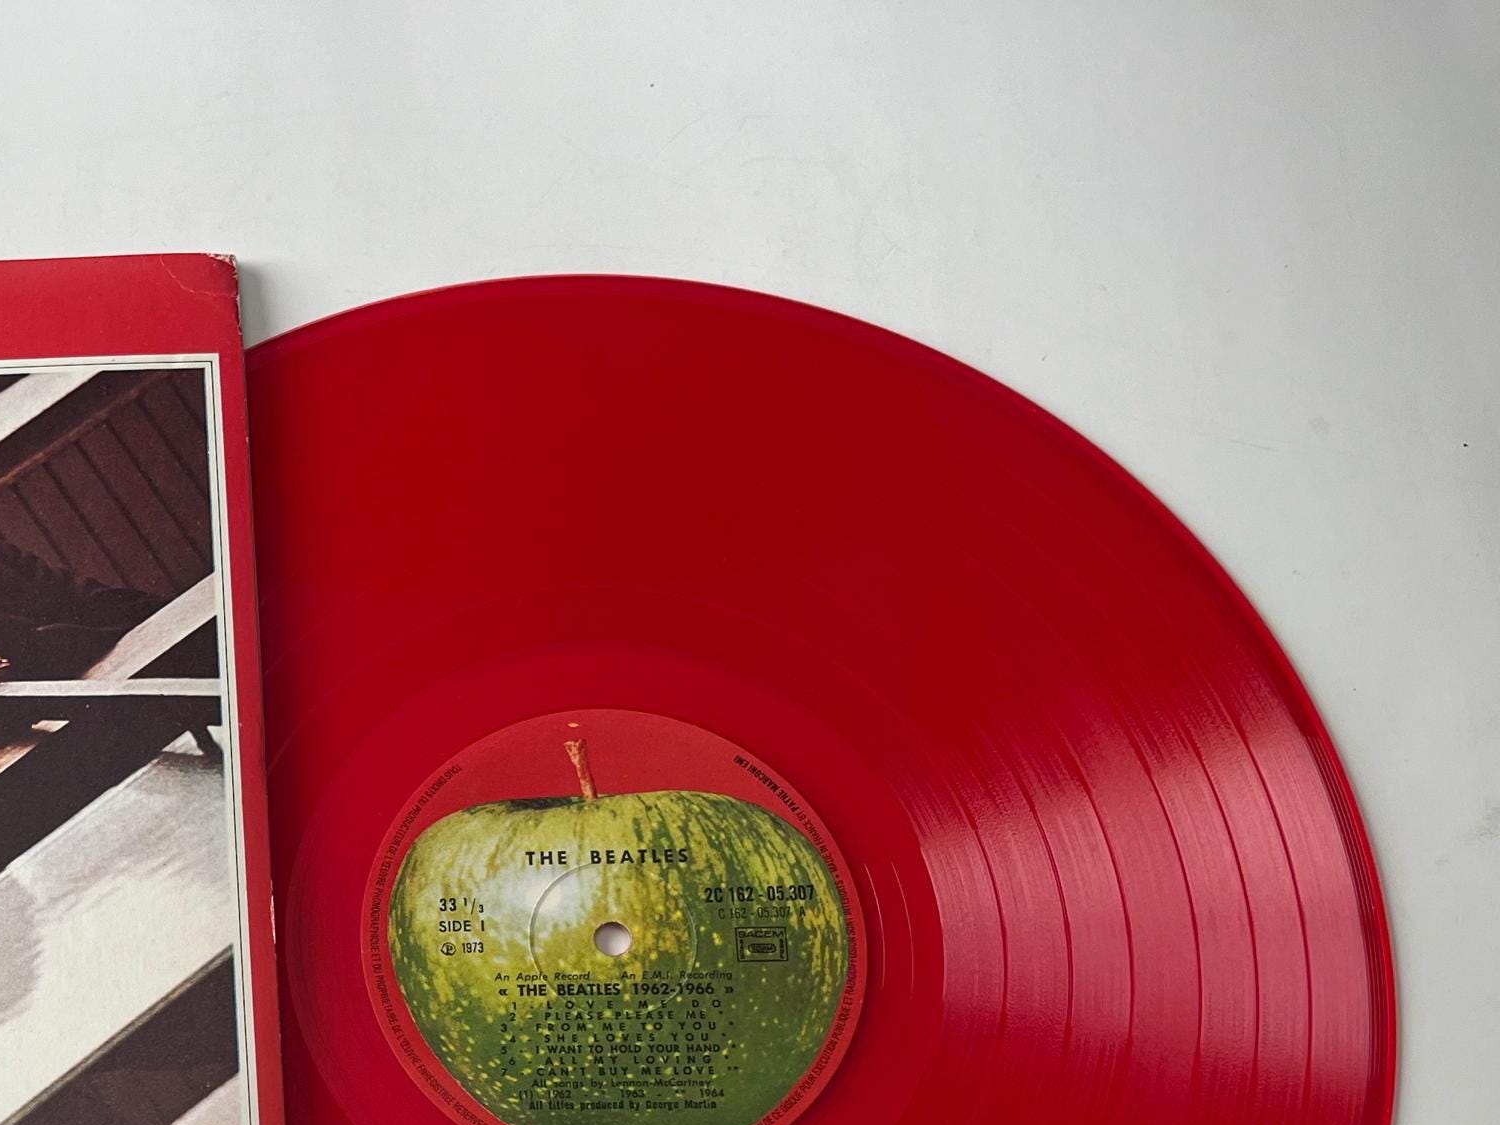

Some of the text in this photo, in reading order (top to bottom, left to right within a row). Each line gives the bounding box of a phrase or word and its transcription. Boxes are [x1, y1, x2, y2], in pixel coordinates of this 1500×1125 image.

[731, 754, 750, 769] EMI
[746, 763, 780, 793] MARCONI
[526, 848, 688, 865] THE BEATLES
[704, 887, 723, 903] 2C
[728, 886, 754, 902] 162
[767, 884, 814, 901] 05.307
[439, 898, 457, 912] 33
[718, 908, 726, 919] C
[730, 907, 747, 919] 162
[756, 906, 791, 918] 05.307
[438, 920, 472, 932] SIDE
[738, 930, 784, 938] SACEM
[461, 942, 484, 953] 1973
[494, 971, 590, 981] An Apple Record
[621, 971, 636, 980] An
[680, 970, 733, 981] Recording
[517, 984, 547, 996] THE
[556, 983, 621, 996] BEATLES
[632, 982, 714, 995] 1962-1966
[546, 1000, 613, 1010] LOVE
[638, 1000, 667, 1009] ME
[692, 999, 721, 1008] DO
[509, 1012, 516, 1021] 2
[544, 1011, 604, 1021] PLEASE
[615, 1010, 674, 1020] PLEASE
[686, 1010, 706, 1019] ME
[500, 1023, 508, 1032] 3
[536, 1023, 587, 1031] FROM
[602, 1022, 626, 1031] ME
[641, 1022, 663, 1031] TO
[678, 1021, 716, 1031] YOU
[544, 1034, 578, 1043] SHE
[594, 1033, 655, 1042] LOVES
[671, 1033, 709, 1041] YOU
[500, 1046, 507, 1055] 5
[546, 1045, 583, 1054] WANT
[589, 1045, 604, 1054] TO
[610, 1044, 642, 1053] HOLD
[648, 1044, 680, 1053] YOUR
[686, 1044, 720, 1053] HAND
[509, 1057, 516, 1066] 6
[545, 1057, 578, 1065] ALL
[594, 1056, 618, 1064] MY
[633, 1055, 712, 1064] LOVING
[500, 1068, 507, 1077] 7
[536, 1067, 586, 1076] CAN'T
[598, 1067, 628, 1076] BUY
[641, 1066, 661, 1075] ME
[673, 1066, 715, 1075] LOVE
[591, 1079, 604, 1088] by
[548, 1090, 571, 1099] 1962
[620, 1089, 645, 1098] 1963
[700, 1088, 725, 1098] 1964
[529, 1101, 543, 1110] All
[548, 1101, 574, 1110] titles
[580, 1100, 624, 1111] produced
[629, 1100, 640, 1111] by
[684, 1100, 717, 1109] Martin
